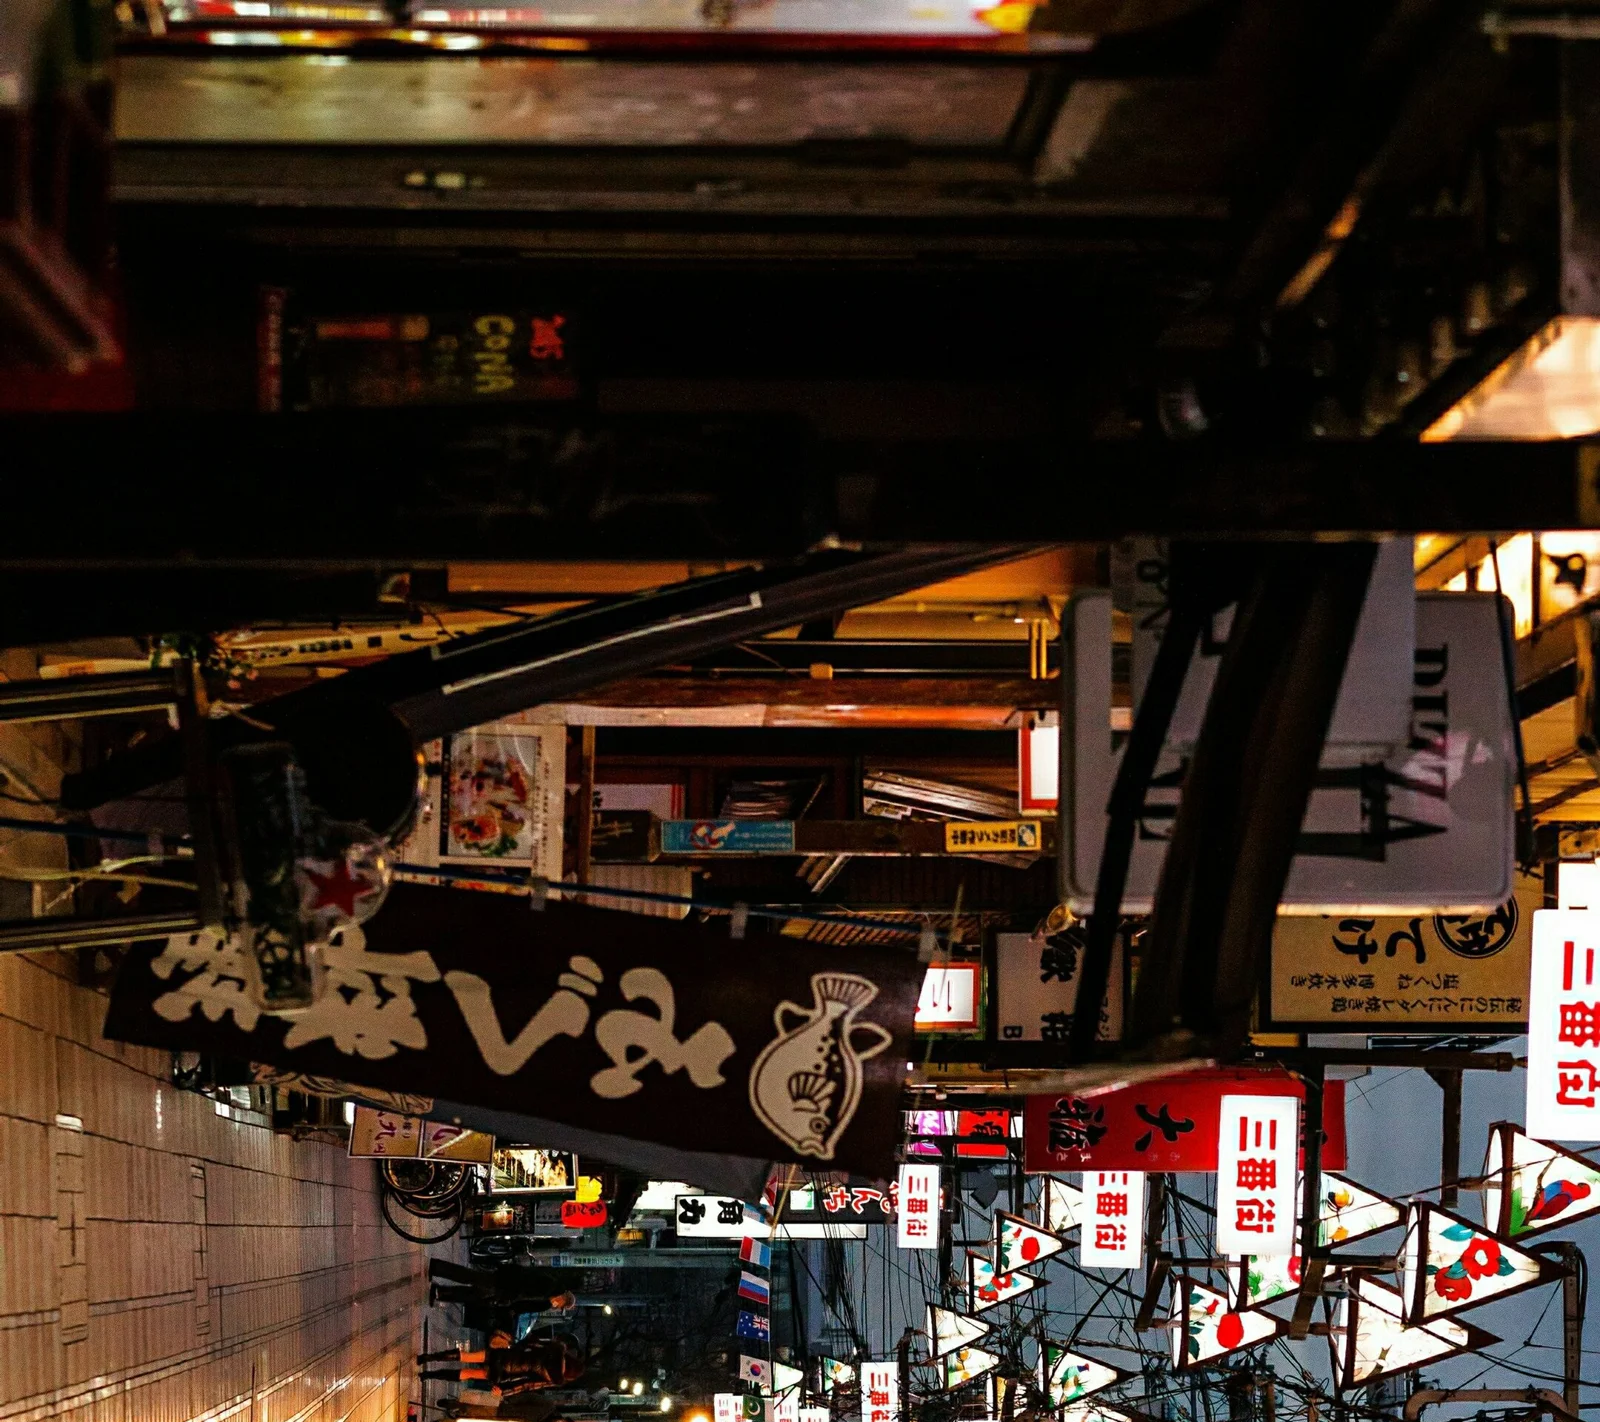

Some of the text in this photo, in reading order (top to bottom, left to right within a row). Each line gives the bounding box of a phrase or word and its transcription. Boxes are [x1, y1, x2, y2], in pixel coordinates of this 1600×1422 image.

[1290, 972, 1459, 990] 塩つくね 博多水炊き
[1331, 996, 1522, 1014] 秘伝のにんにくダレ焼き鶏
[1235, 1116, 1277, 1233] 三番街
[678, 1198, 745, 1226] 角力
[906, 1176, 928, 1236] 三番街
[1095, 1173, 1128, 1250] 三番街
